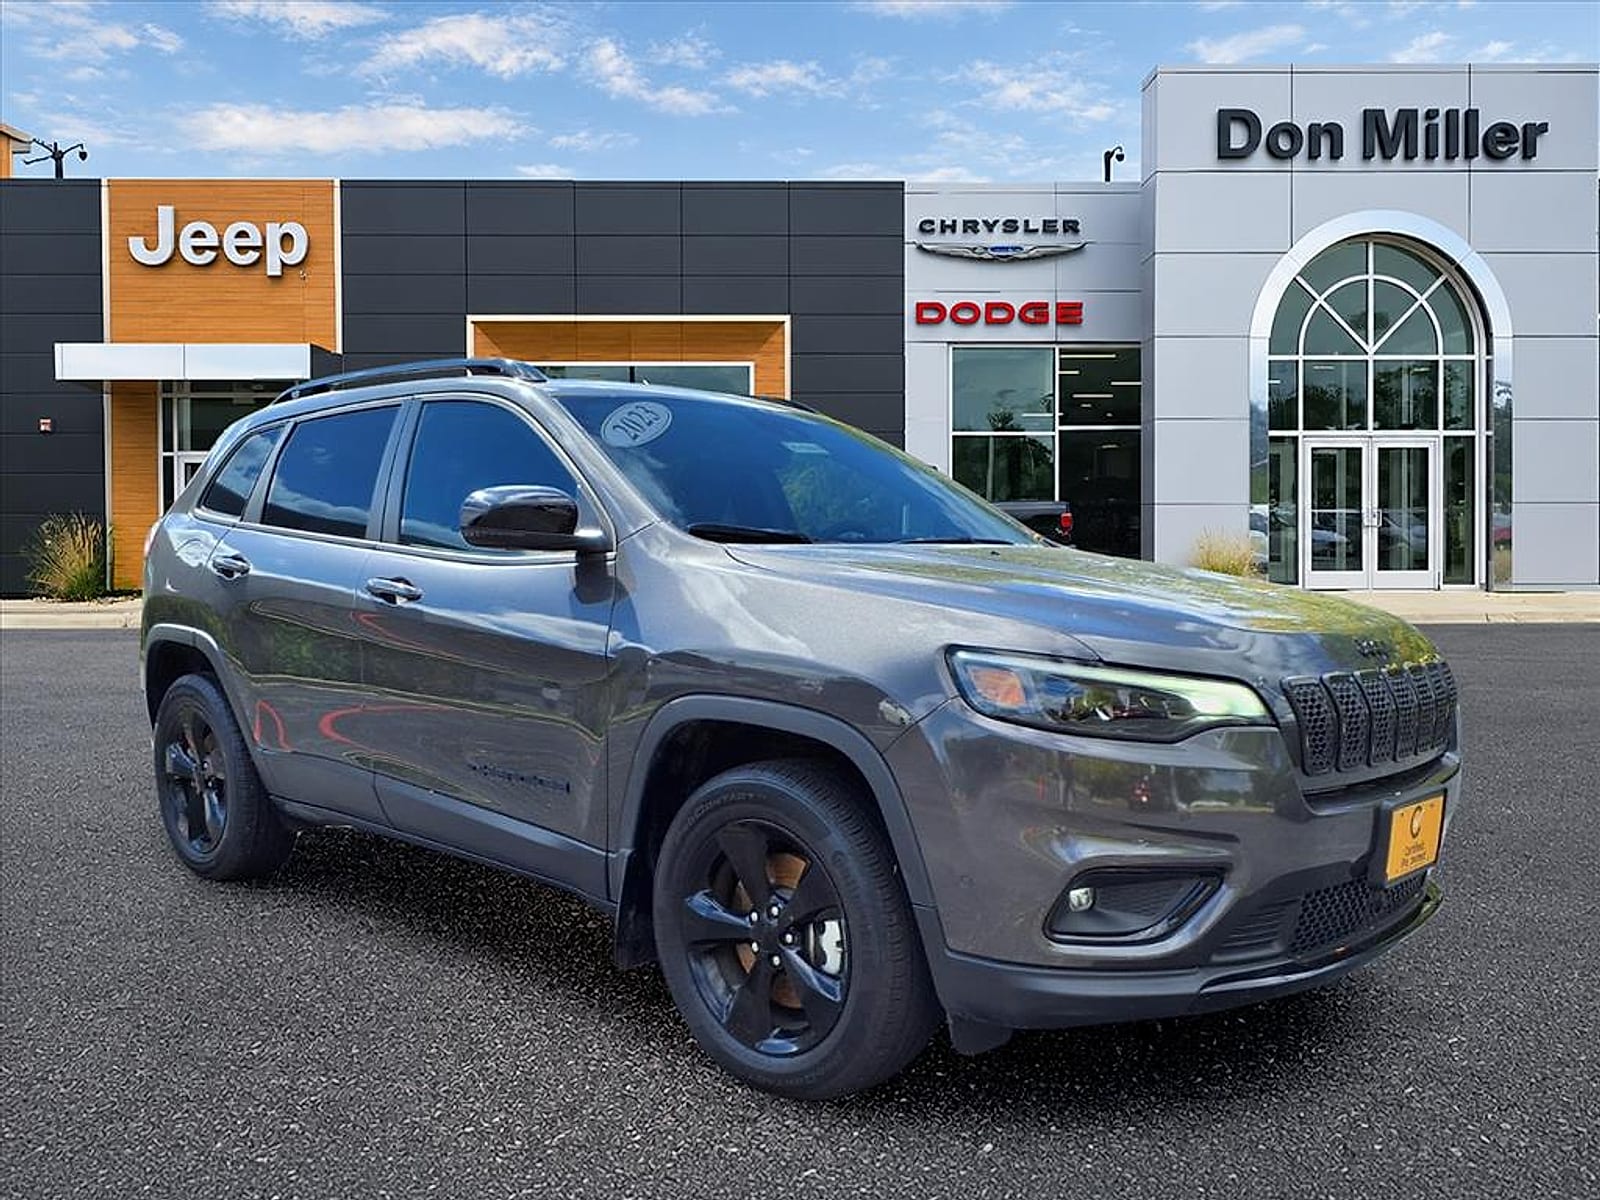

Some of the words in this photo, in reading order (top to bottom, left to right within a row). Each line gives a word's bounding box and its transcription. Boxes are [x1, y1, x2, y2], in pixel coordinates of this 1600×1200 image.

[1217, 108, 1344, 160] Don
[1362, 108, 1549, 161] Miller
[127, 205, 309, 277] Jeep
[918, 219, 1081, 234] CHRYSLER
[915, 302, 1083, 325] DODGE
[612, 405, 661, 441] 2023
